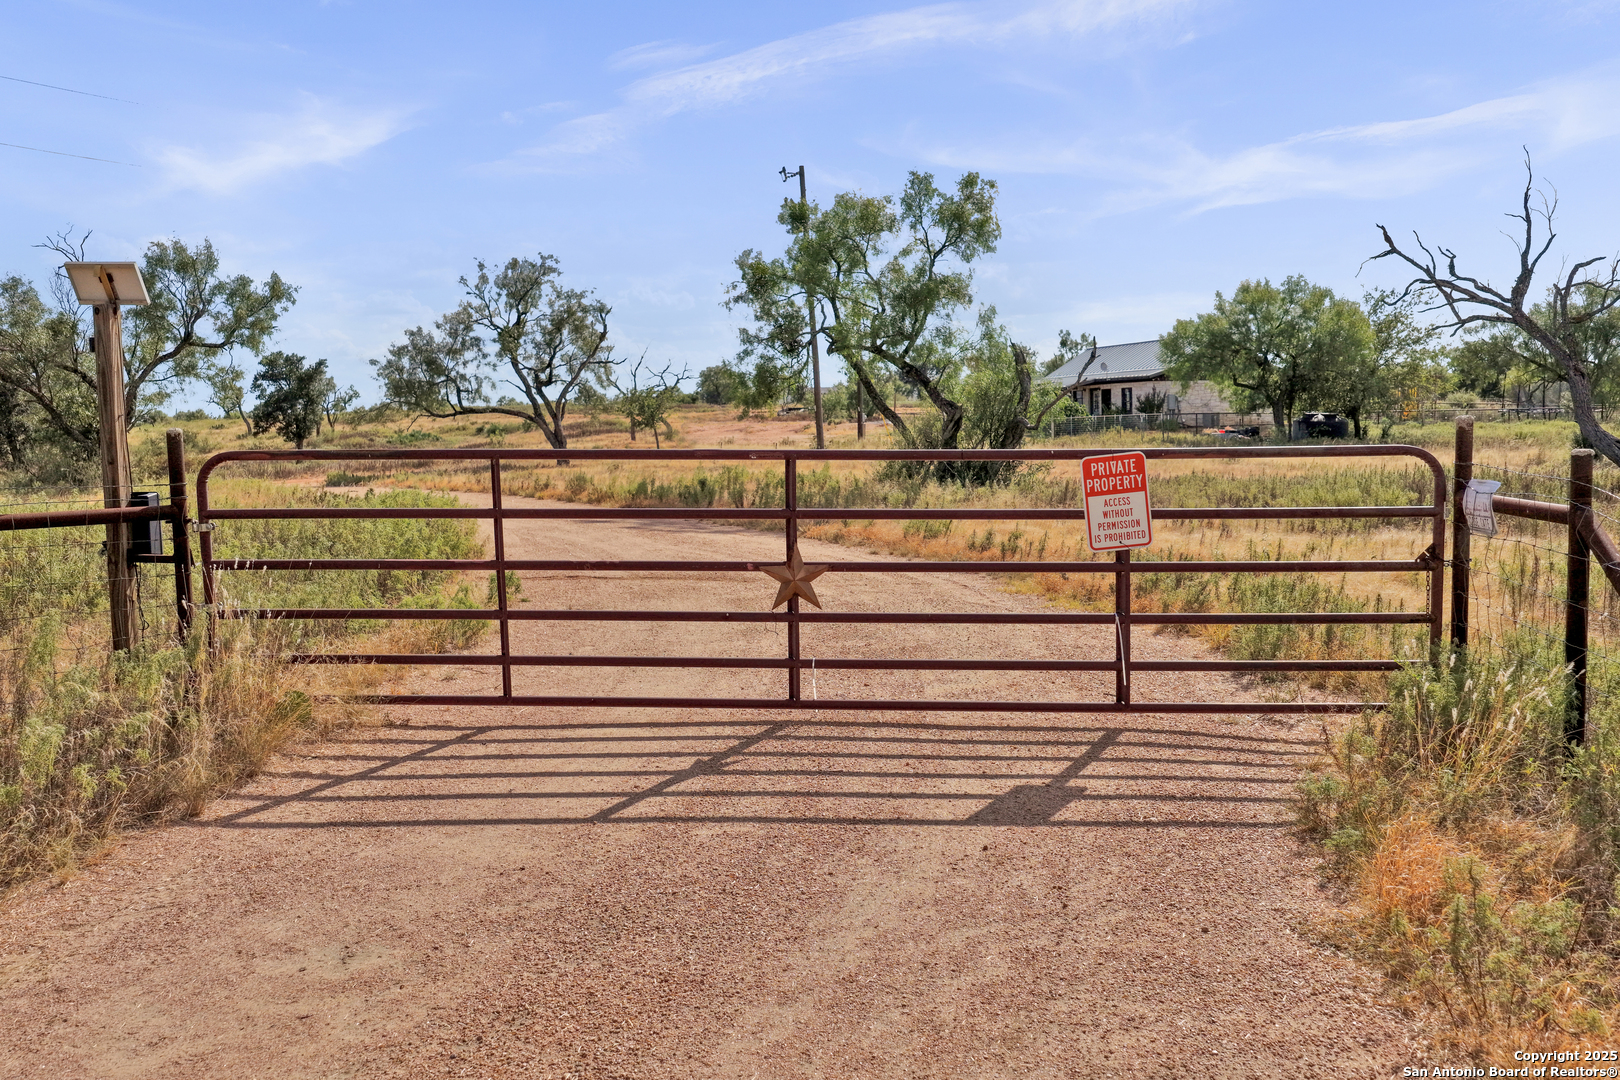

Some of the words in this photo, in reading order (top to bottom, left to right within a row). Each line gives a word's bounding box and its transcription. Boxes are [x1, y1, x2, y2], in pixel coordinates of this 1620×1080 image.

[1091, 458, 1137, 476] PRIVATE
[1087, 474, 1143, 493] PROPERTY
[1103, 496, 1131, 508] ACCESS
[1102, 507, 1134, 519] WITHOUT
[1097, 519, 1141, 532] PERMISSION
[1094, 534, 1102, 543] IS
[1104, 529, 1146, 542] PROHIBITED
